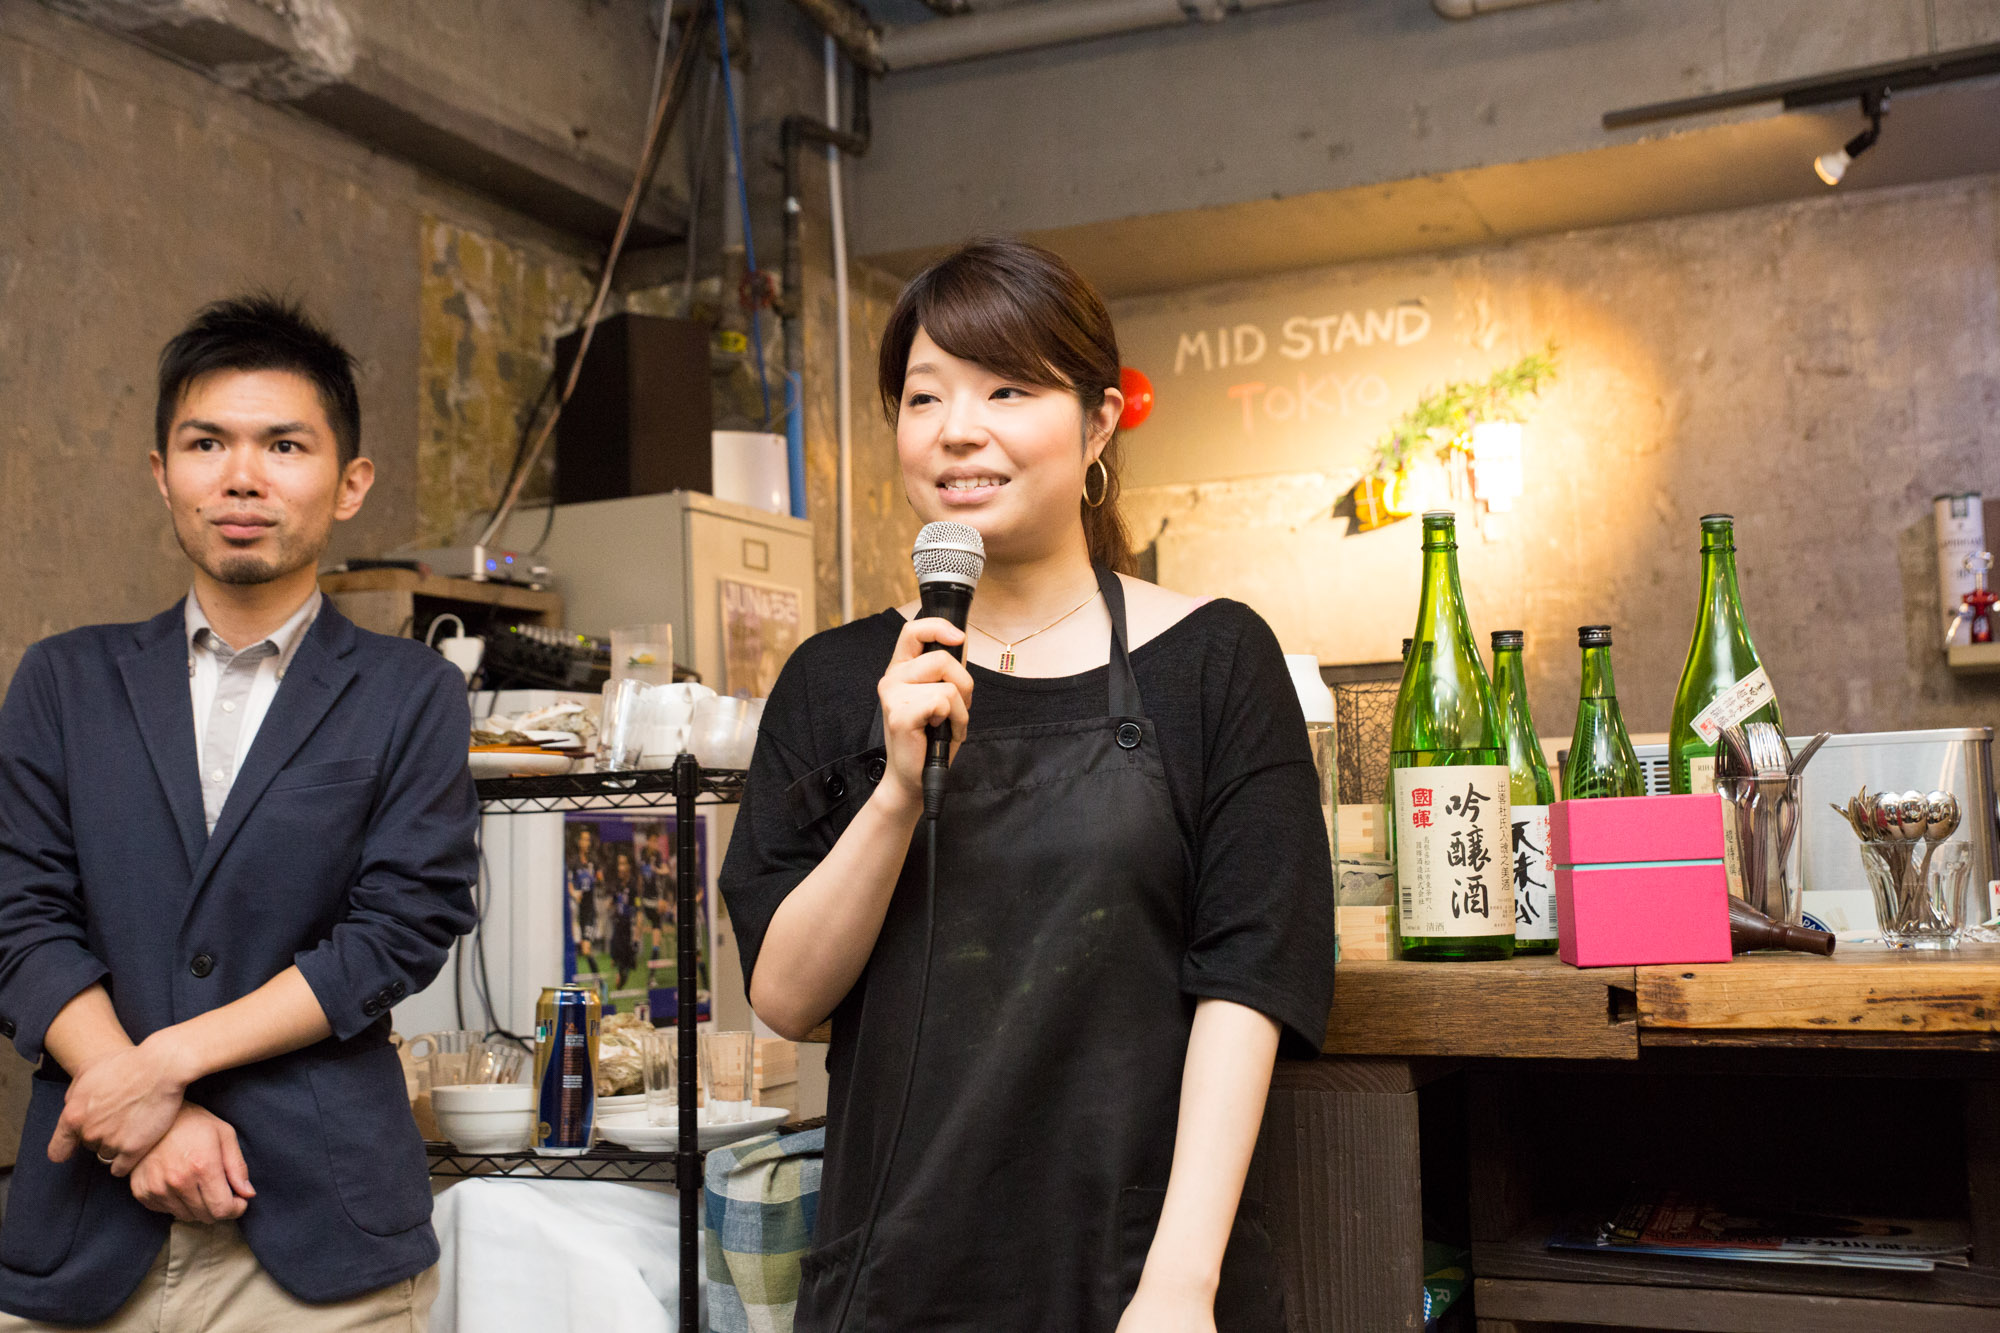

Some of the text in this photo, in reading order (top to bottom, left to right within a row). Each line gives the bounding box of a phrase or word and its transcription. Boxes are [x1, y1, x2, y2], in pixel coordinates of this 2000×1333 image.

[1173, 304, 1432, 376] MID STAND
[1227, 371, 1390, 435] TOKYO
[1411, 788, 1435, 829] 國暉
[1445, 782, 1492, 919] 吟醸酒
